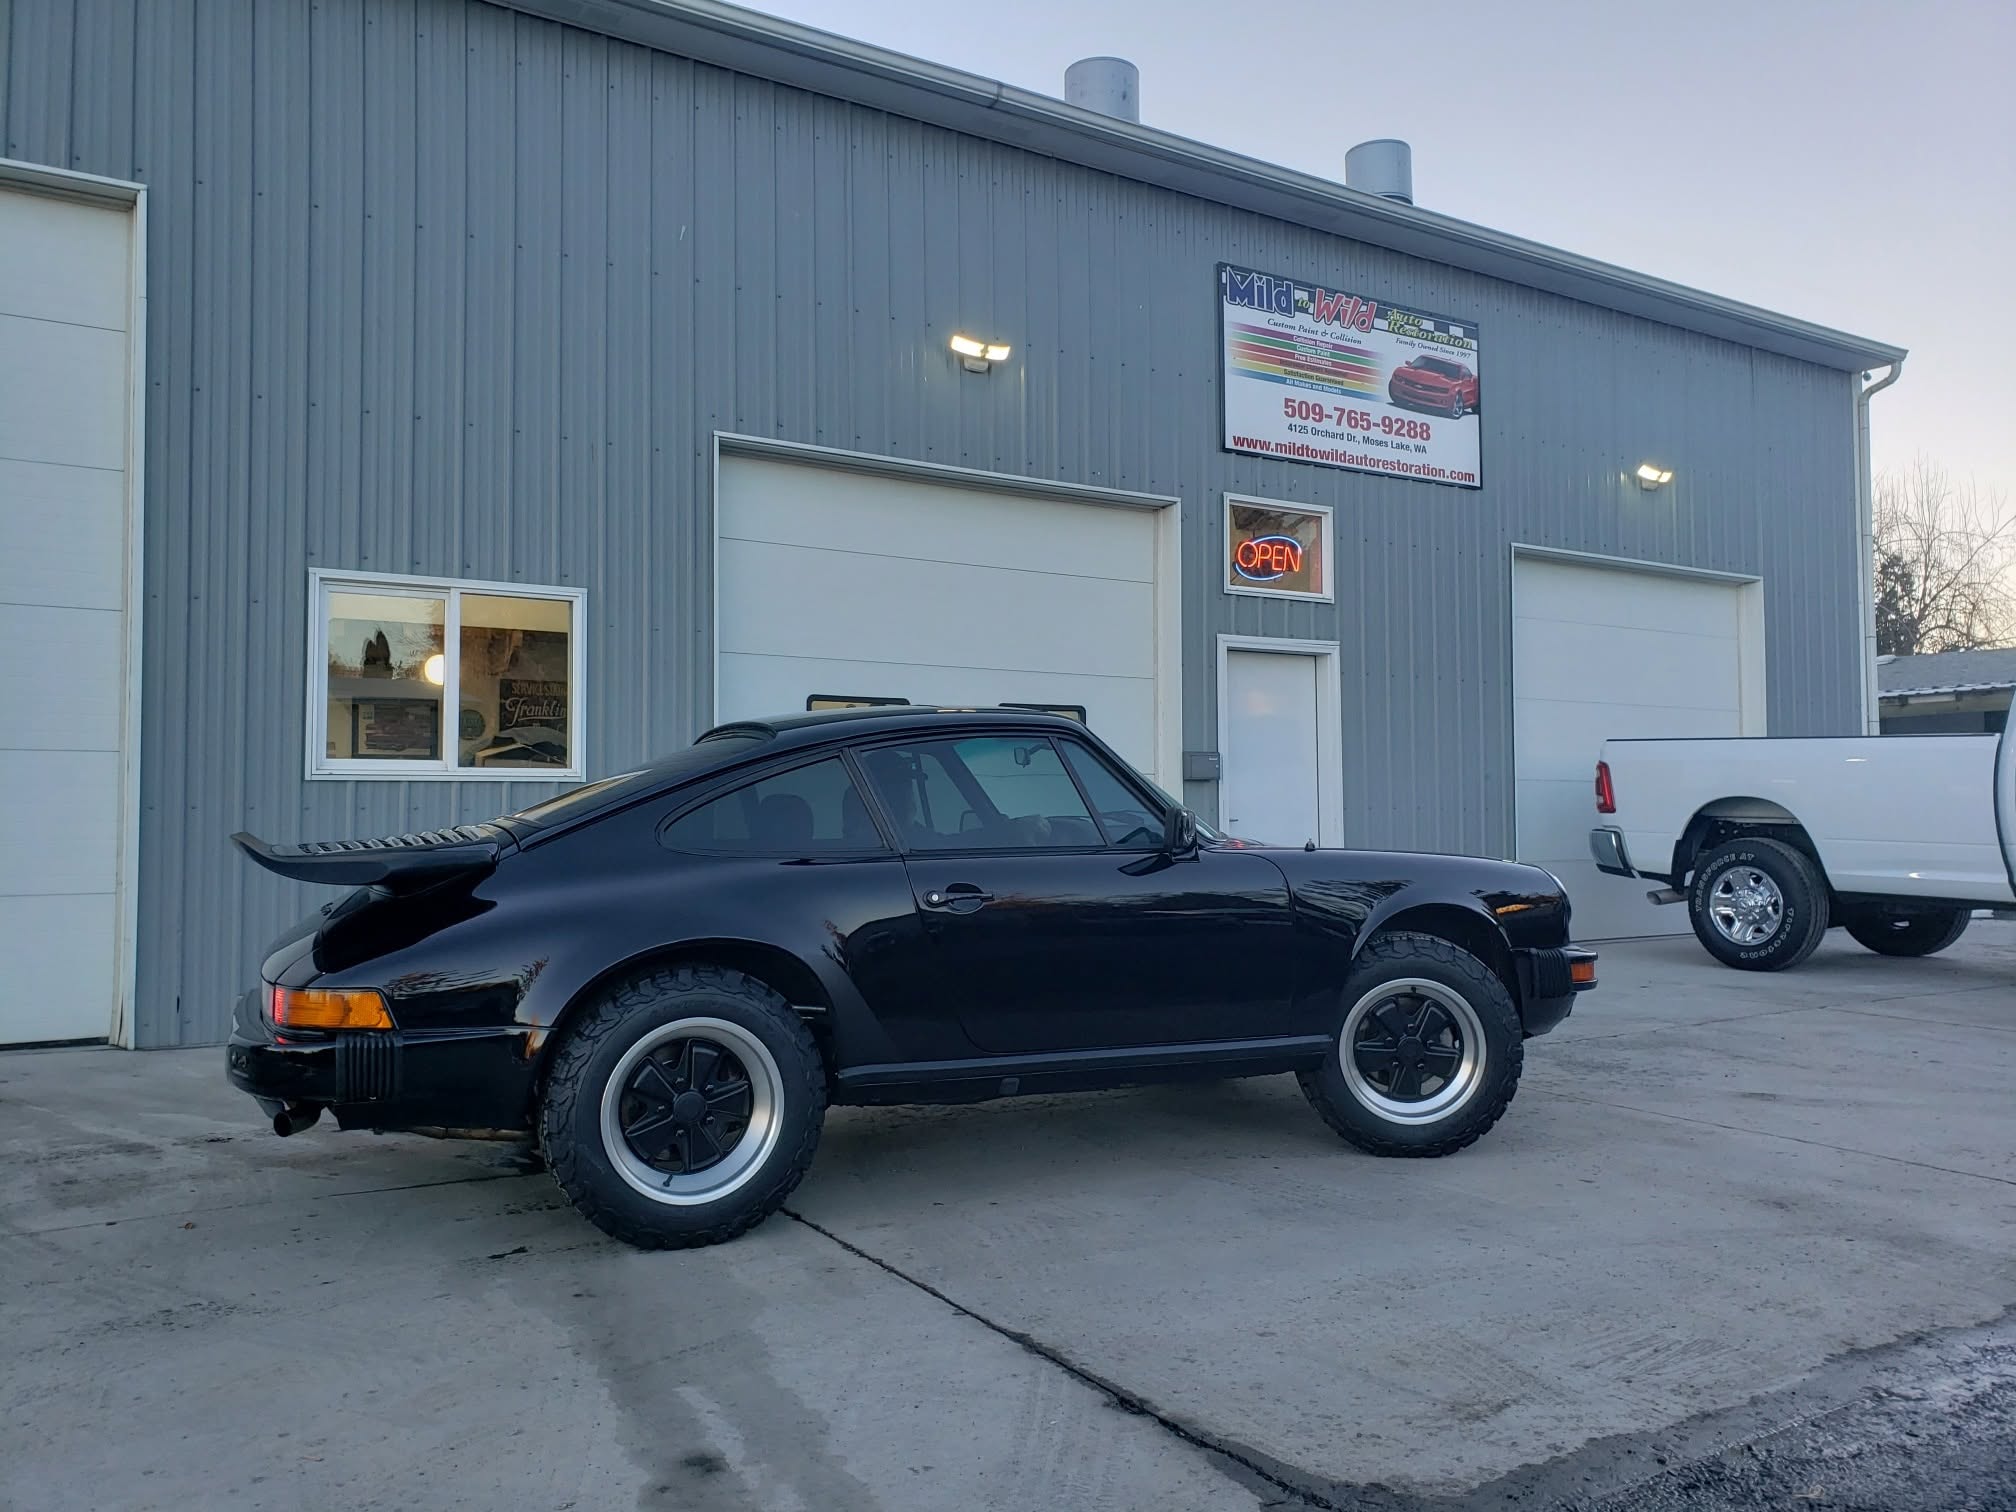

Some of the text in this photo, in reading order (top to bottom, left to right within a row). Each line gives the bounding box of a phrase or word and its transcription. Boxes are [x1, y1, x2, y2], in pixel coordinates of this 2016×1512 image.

[1227, 266, 1377, 333] Mild to Wild
[1386, 308, 1423, 326] Auto
[1267, 318, 1362, 345] Custom Paint & Collision
[1293, 335, 1333, 350] Collision Repair
[1389, 320, 1473, 350] Restoration
[1294, 354, 1332, 367] Free Estimates
[1296, 345, 1331, 357] Custom Paint
[1396, 338, 1471, 359] Family Owned Since 1997
[1283, 368, 1315, 380] Satisfaction
[1294, 380, 1312, 389] Makes
[1323, 385, 1342, 394] Models
[1284, 397, 1431, 441] 509-765-9288
[1287, 424, 1428, 454] 4125 Orchard Dr., Moses Lake, WA
[1232, 435, 1475, 483] www.mildtowildautorestoration.com
[1237, 541, 1301, 572] OPEN
[506, 697, 567, 726] Franklin
[1739, 852, 1755, 861] AT
